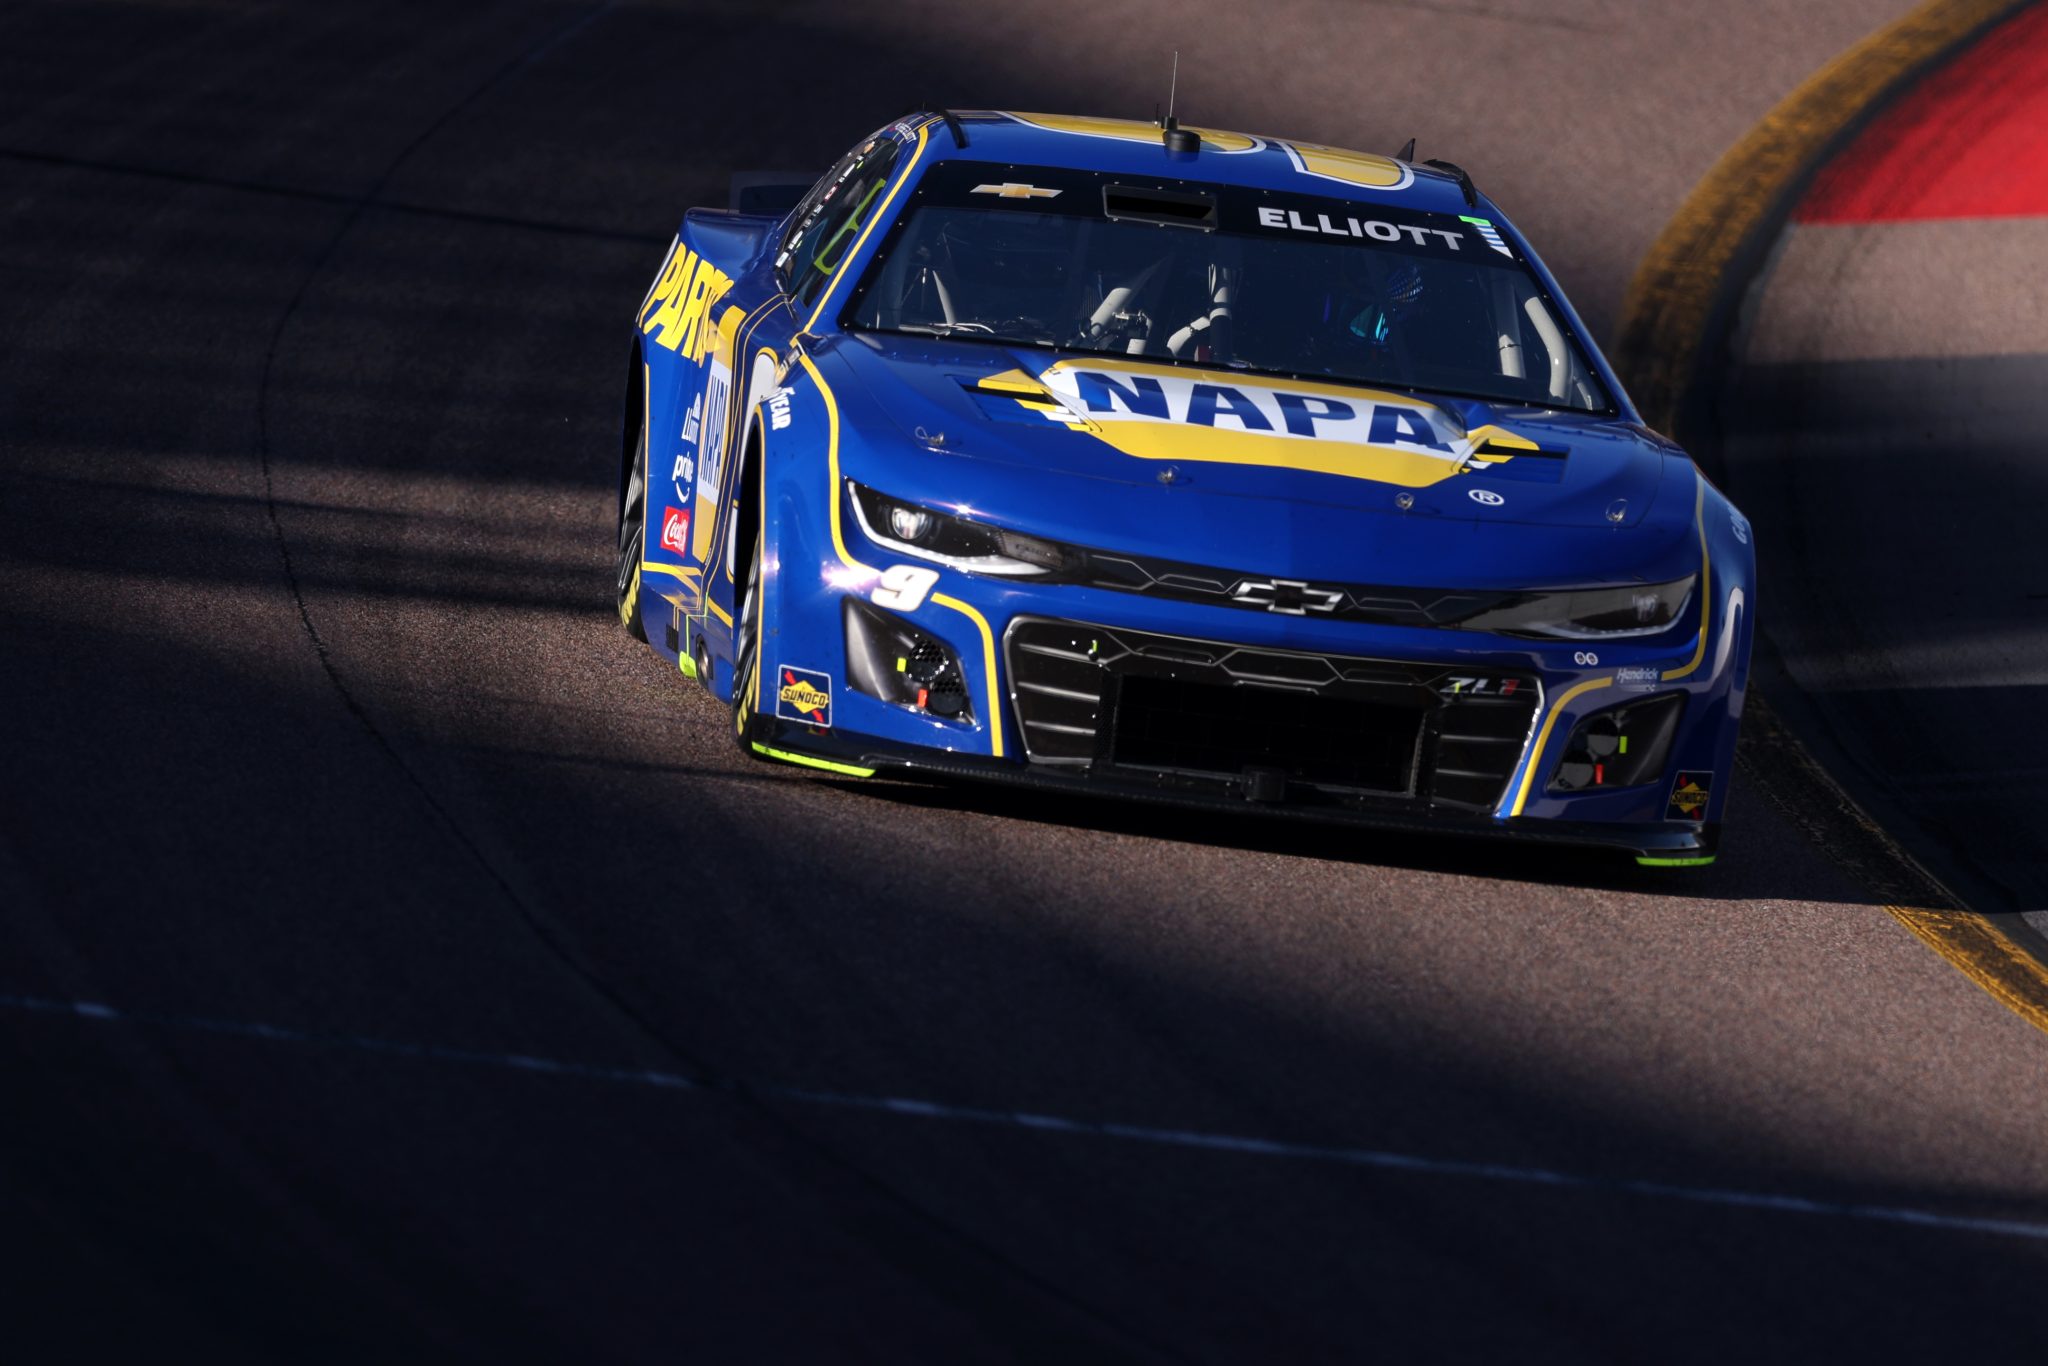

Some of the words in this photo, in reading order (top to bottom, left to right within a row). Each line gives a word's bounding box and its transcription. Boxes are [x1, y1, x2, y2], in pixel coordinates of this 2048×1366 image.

[1258, 206, 1464, 251] ELLIOTT
[1074, 372, 1456, 453] NAPA
[870, 564, 941, 612] 9
[782, 688, 827, 707] SUNOCO
[1617, 667, 1659, 684] Hendrick
